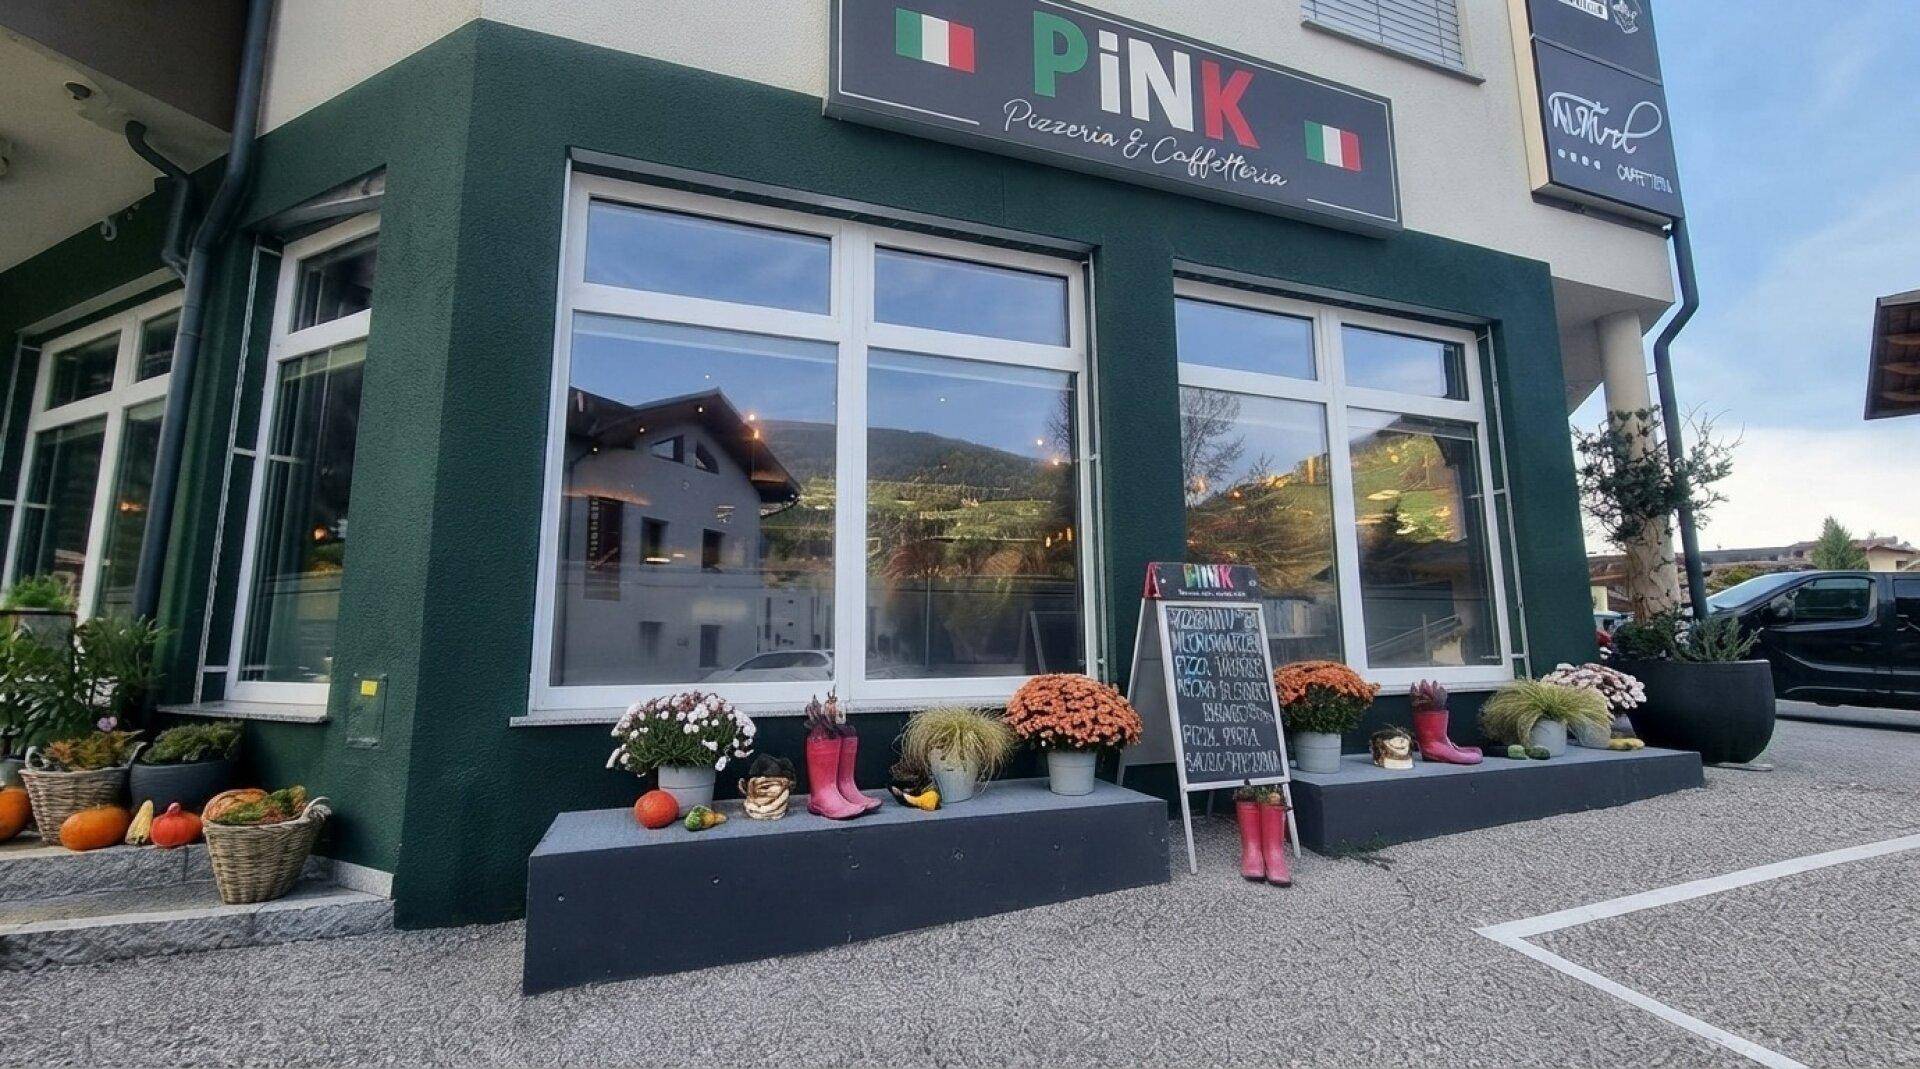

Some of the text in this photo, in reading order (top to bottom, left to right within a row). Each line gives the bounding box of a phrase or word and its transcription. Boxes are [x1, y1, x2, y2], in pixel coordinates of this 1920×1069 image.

[1003, 98, 1288, 187] Pizzeria & Caffetteria
